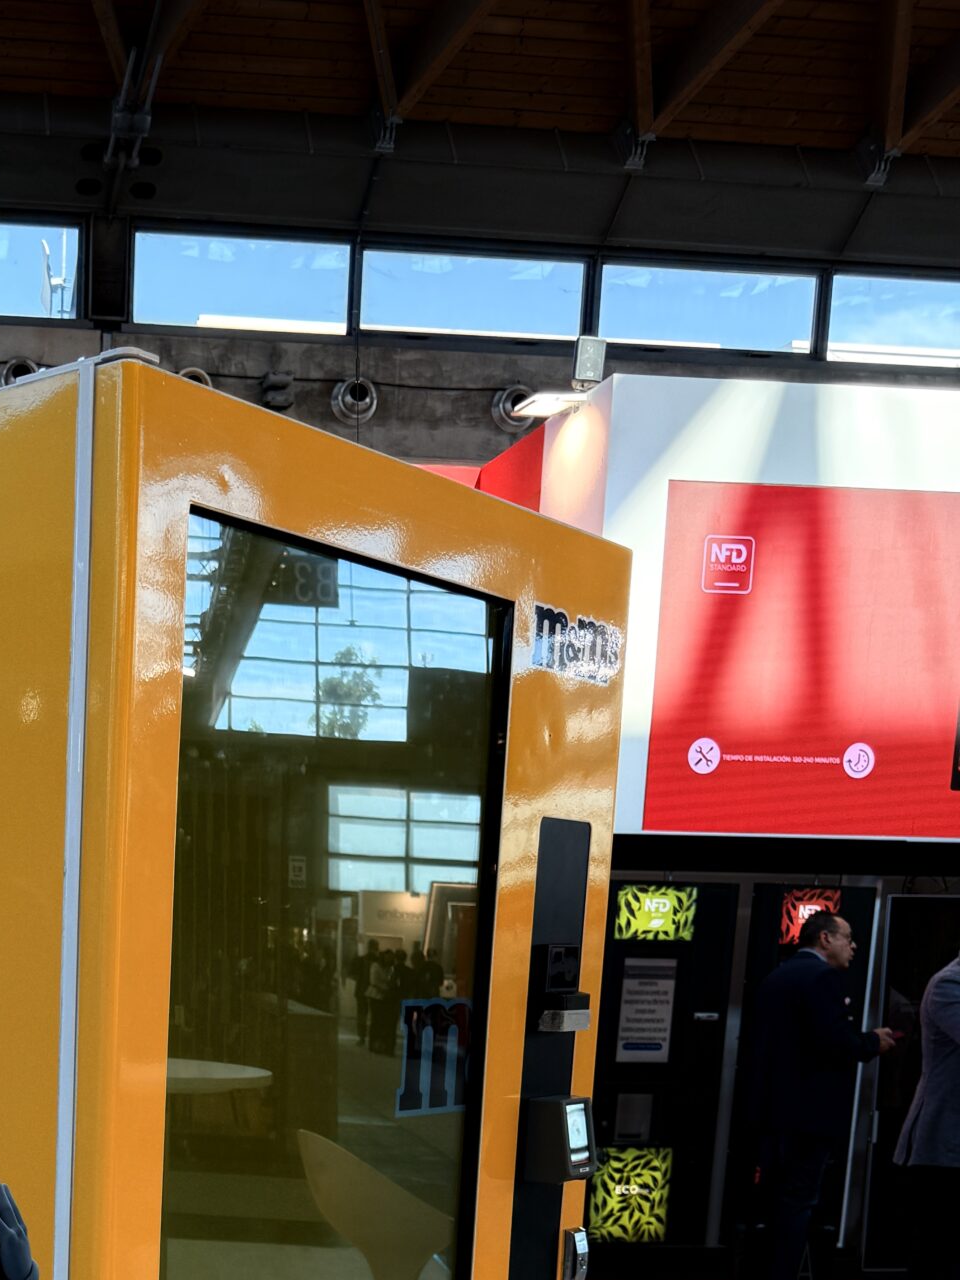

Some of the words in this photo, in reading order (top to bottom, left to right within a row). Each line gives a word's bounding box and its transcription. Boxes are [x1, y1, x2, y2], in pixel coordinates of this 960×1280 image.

[710, 543, 748, 563] NFD
[710, 564, 747, 572] STANDARD
[722, 753, 744, 762] TIEMPO
[745, 754, 753, 762] DE
[814, 756, 841, 765] MINUTOS
[644, 898, 671, 913] NFD
